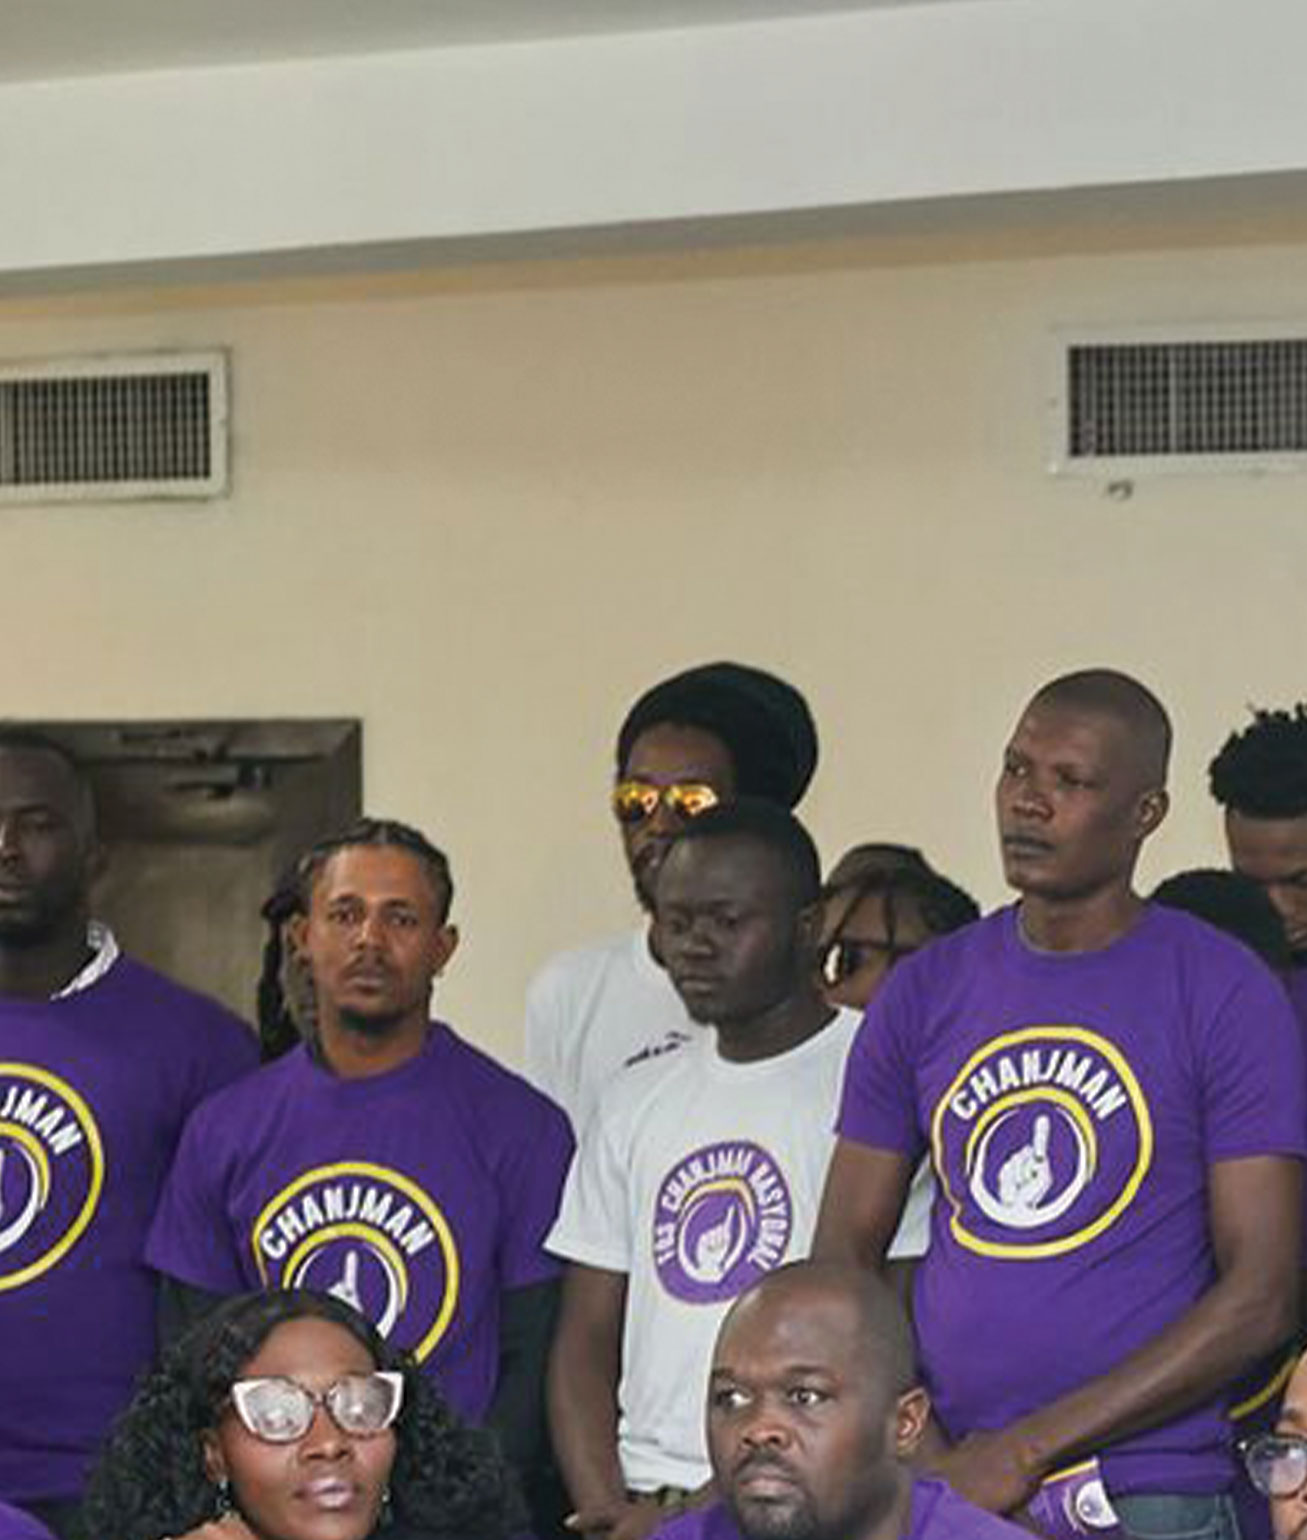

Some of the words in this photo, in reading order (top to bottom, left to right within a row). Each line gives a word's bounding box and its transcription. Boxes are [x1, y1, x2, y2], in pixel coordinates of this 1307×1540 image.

[0, 1086, 83, 1156] JMAN
[949, 1050, 1126, 1121] CHANJMAN
[260, 1186, 435, 1260] CHANJMAN
